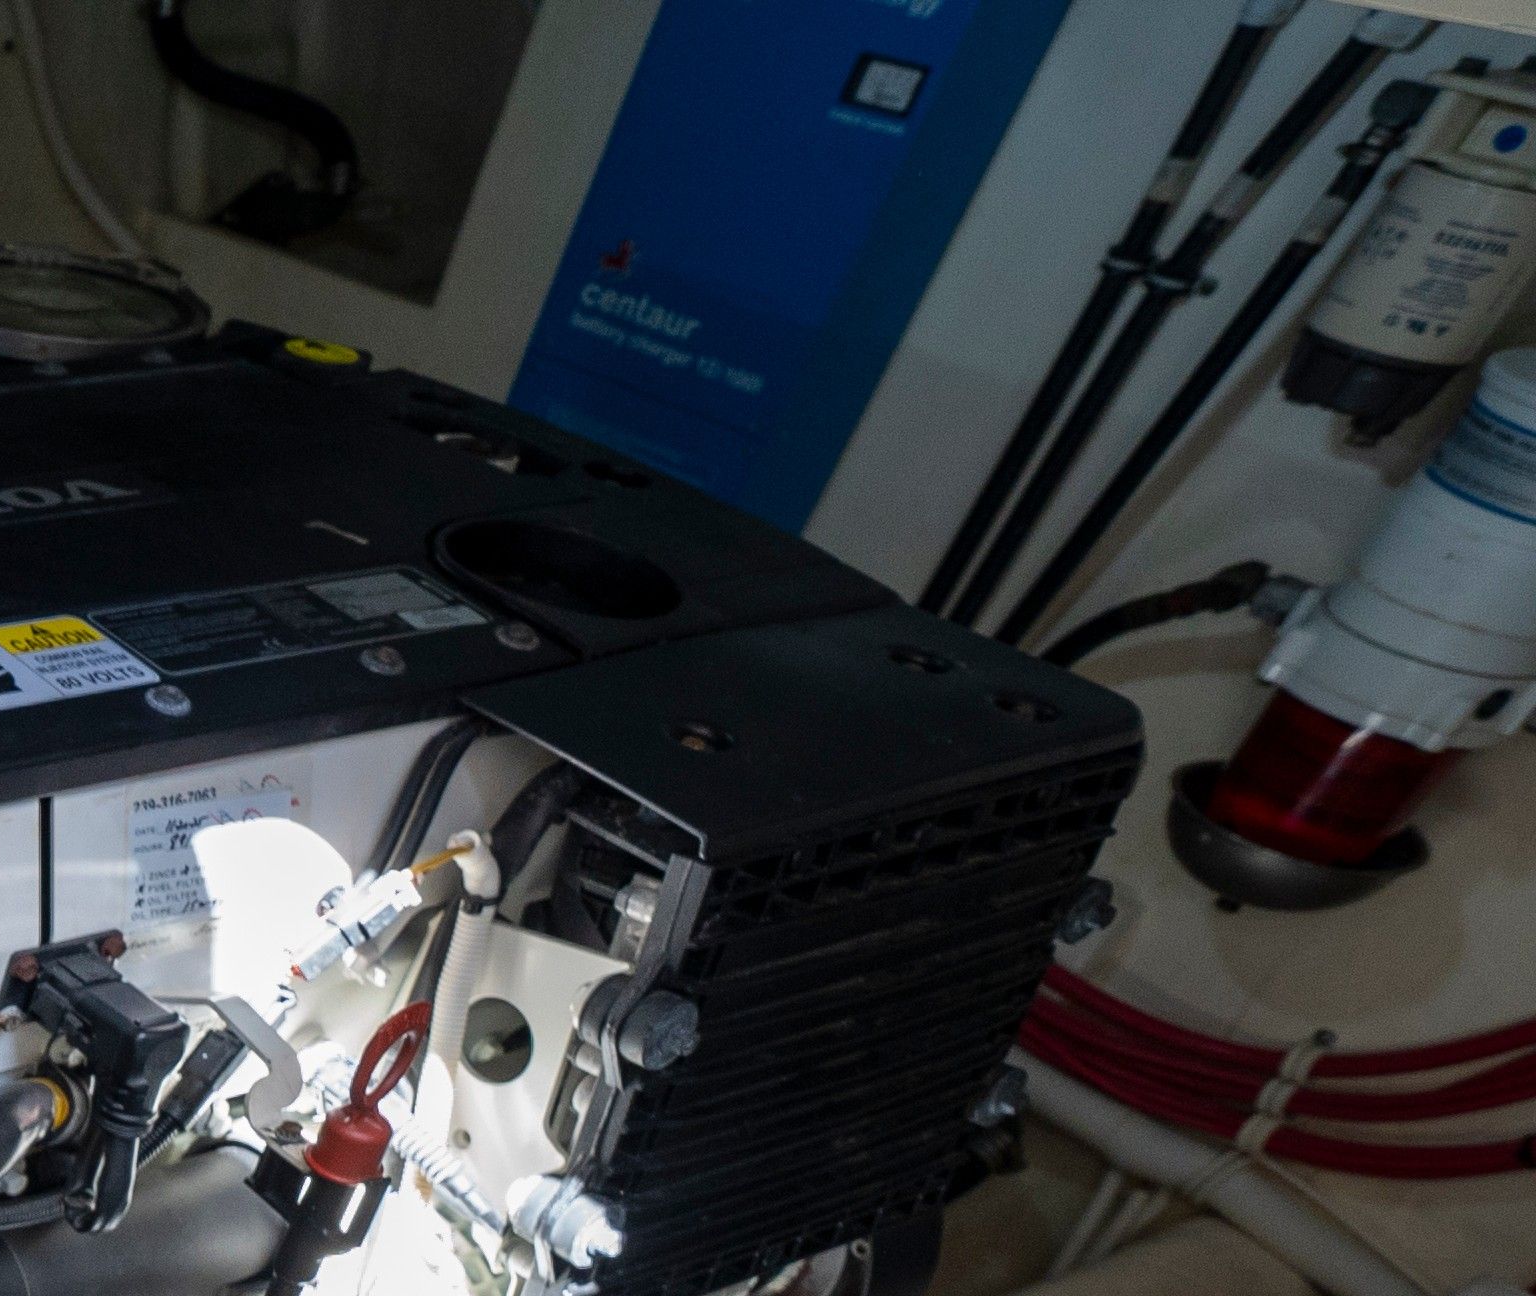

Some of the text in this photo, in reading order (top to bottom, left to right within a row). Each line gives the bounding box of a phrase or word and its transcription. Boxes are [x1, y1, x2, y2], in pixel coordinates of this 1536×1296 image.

[580, 282, 702, 339] centaur
[10, 629, 97, 653] CAUTION
[56, 665, 145, 689] 80 VOLTS
